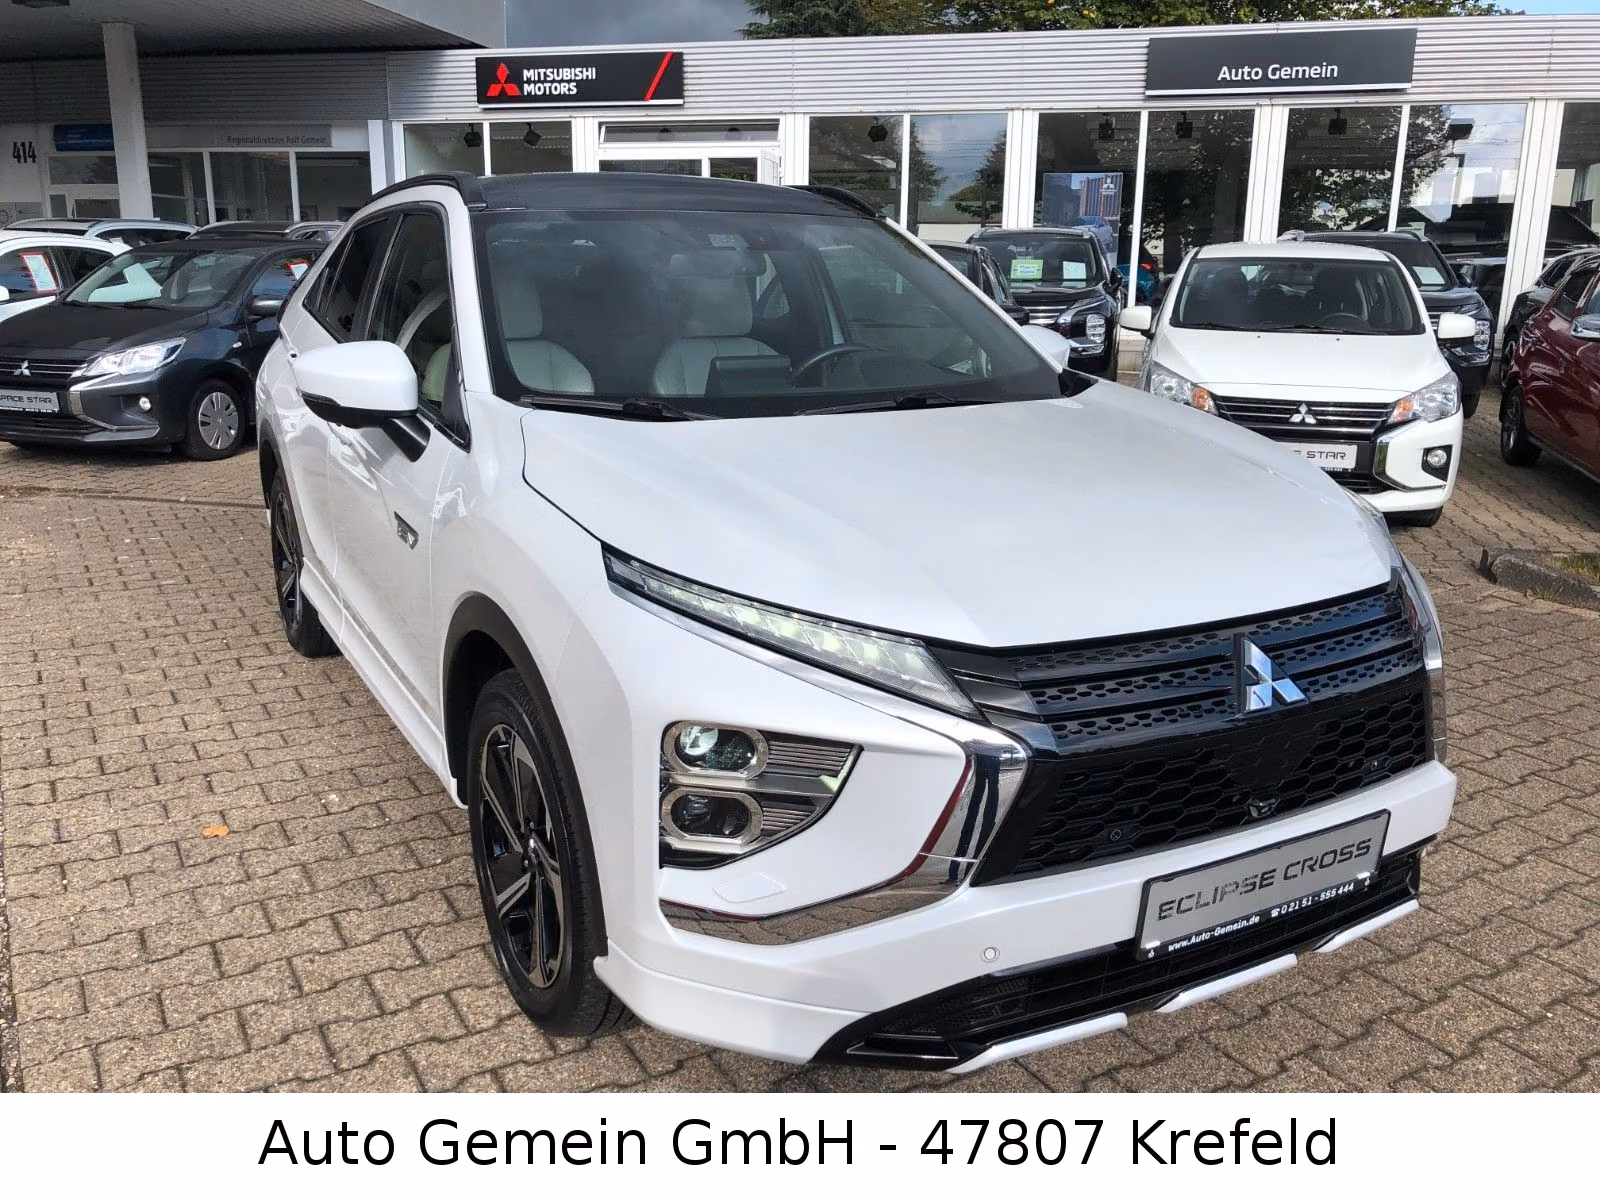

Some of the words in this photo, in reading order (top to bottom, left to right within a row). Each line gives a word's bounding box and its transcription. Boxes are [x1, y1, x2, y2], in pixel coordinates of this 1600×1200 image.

[523, 67, 597, 82] MITSUBISHI
[1217, 65, 1262, 81] Auto
[1267, 62, 1339, 80] Gemein
[523, 82, 578, 96] MOTORS
[12, 141, 37, 164] 414
[27, 396, 52, 404] STAR
[1306, 450, 1347, 460] STAR
[1157, 869, 1277, 921] ECLIPSE
[1283, 838, 1373, 881] CROSS
[1168, 913, 1260, 952] www.Auto-Gemein.de
